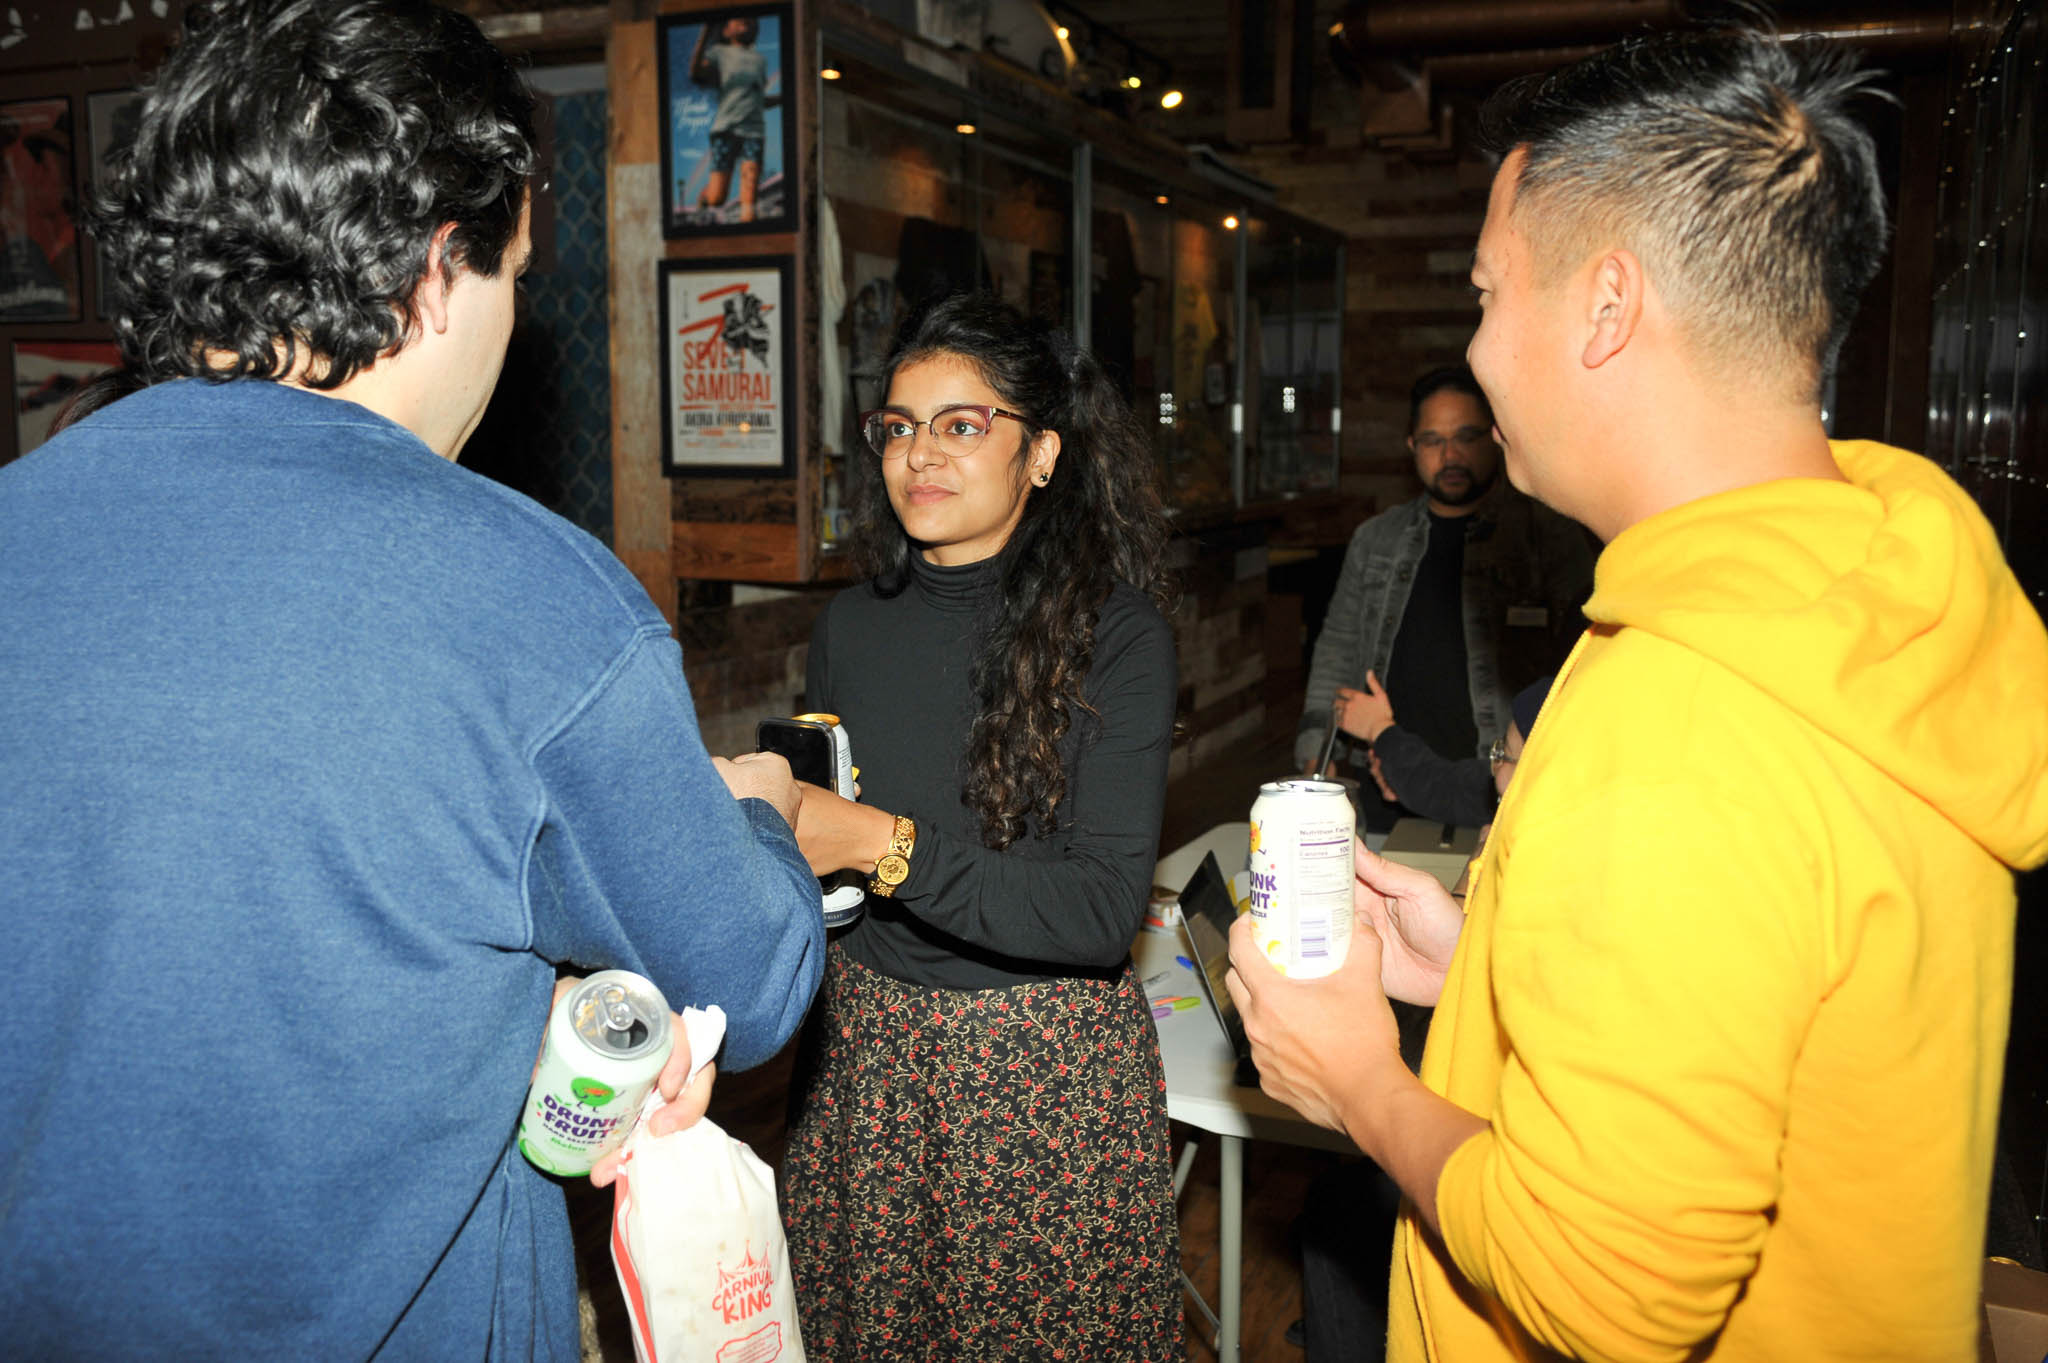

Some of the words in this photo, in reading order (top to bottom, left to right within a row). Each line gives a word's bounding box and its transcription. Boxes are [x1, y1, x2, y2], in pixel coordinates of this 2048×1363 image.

[683, 372, 771, 401] SAMURAI
[1250, 871, 1278, 891] UNK
[1250, 889, 1270, 909] UIT
[544, 1094, 626, 1128] DRUNK
[545, 1111, 614, 1139] FRUIT
[712, 1269, 774, 1311] CARNIVAL
[722, 1288, 772, 1325] KING
